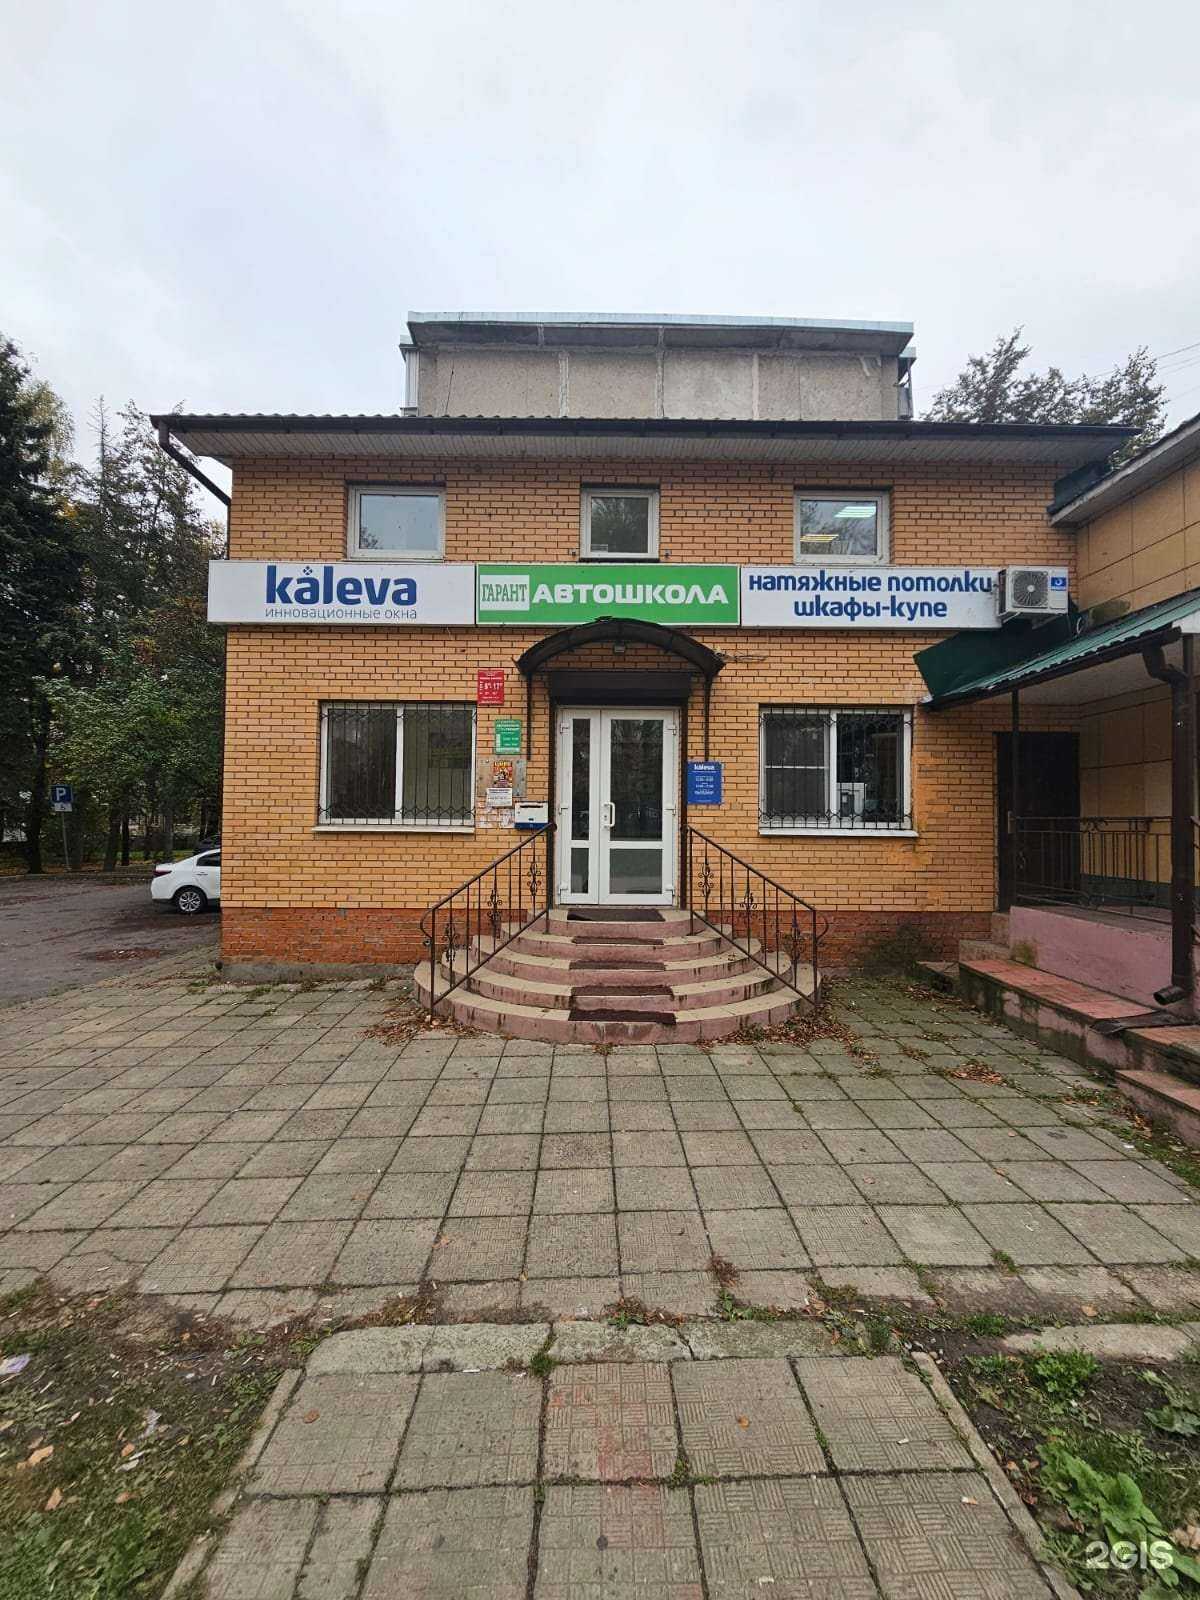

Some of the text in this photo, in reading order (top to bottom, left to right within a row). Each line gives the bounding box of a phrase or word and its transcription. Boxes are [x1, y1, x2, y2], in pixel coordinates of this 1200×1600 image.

[265, 565, 417, 606] kaleva
[749, 570, 993, 592] натяжные потолки
[480, 583, 528, 602] ГАРАНТ
[532, 583, 729, 604] АВТОШКОЛА
[265, 608, 417, 620] инновационные окна
[794, 595, 947, 621] шкафы-купе
